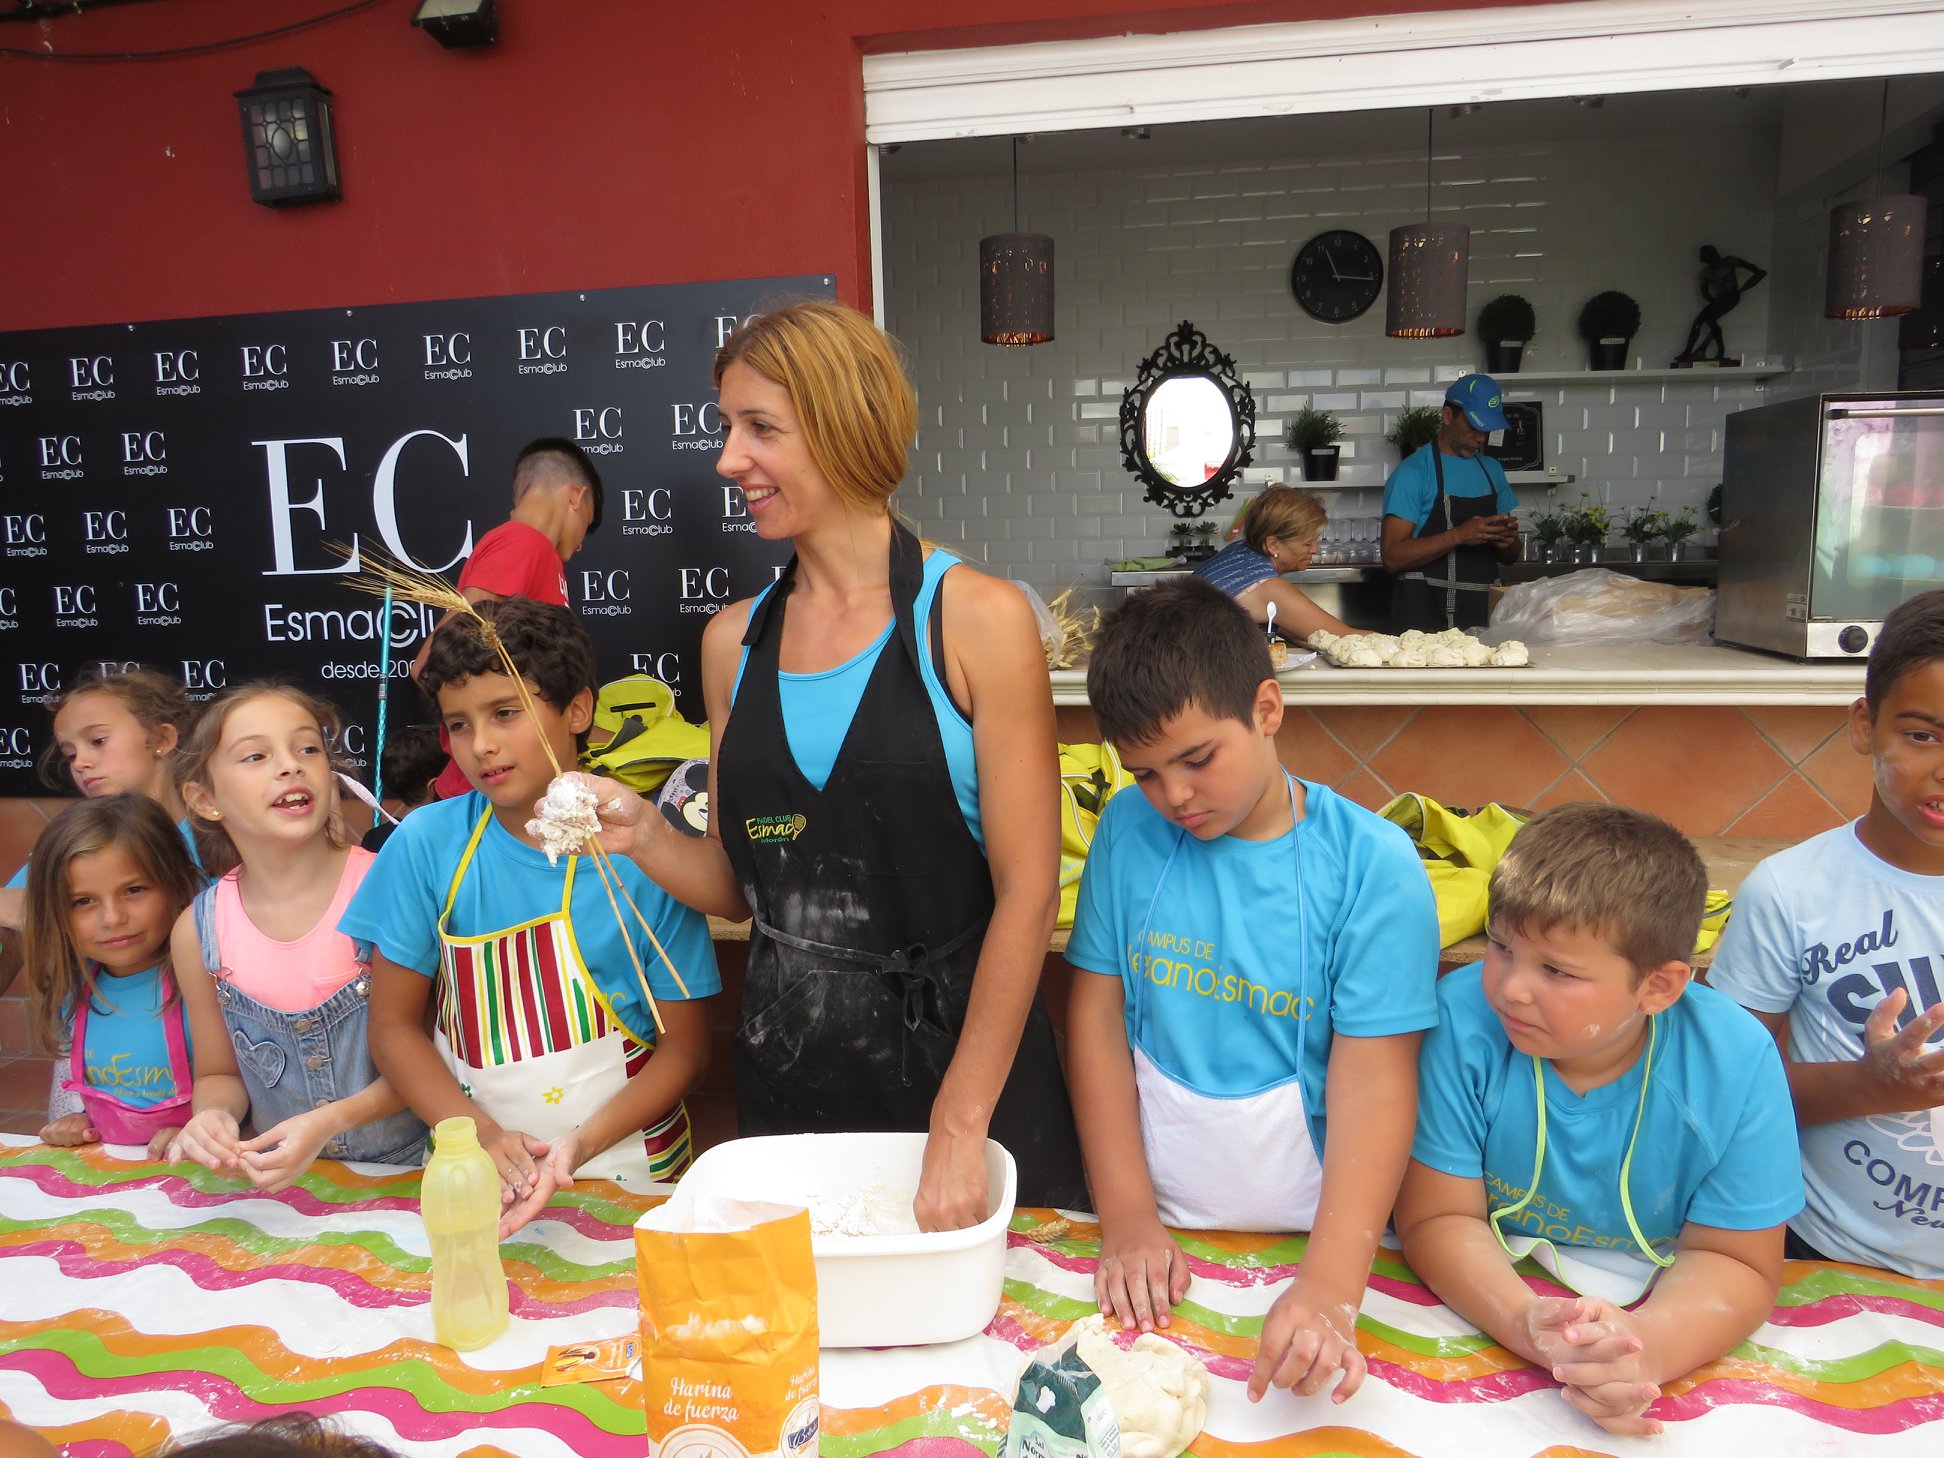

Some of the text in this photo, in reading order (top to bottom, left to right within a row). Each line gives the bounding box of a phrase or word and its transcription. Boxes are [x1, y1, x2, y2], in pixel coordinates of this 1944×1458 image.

[423, 333, 470, 365] EC
[517, 327, 566, 359] EC
[615, 321, 664, 353] EC
[155, 351, 199, 381] EC
[241, 345, 287, 376] EC
[331, 339, 377, 371] EC
[70, 356, 113, 387] EC
[0, 396, 32, 406] maClub
[573, 407, 622, 439] EC
[671, 403, 721, 435] EC
[40, 436, 81, 466] EC
[122, 431, 165, 461] EC
[581, 444, 623, 455] maClub
[251, 429, 474, 576] EC
[622, 489, 671, 520] EC
[721, 486, 747, 518] E
[4, 514, 45, 543] EC
[84, 511, 127, 540] EC
[167, 507, 211, 536] EC
[722, 522, 757, 534] EsmaC
[136, 583, 179, 611] EC
[581, 570, 629, 600] EC
[679, 568, 729, 598] EC
[0, 588, 16, 615] C
[54, 586, 96, 614] EC
[264, 600, 435, 649] EsmaCl
[19, 663, 60, 690] EC
[182, 660, 226, 688] EC
[321, 661, 380, 679] desde
[0, 759, 32, 768] maClub
[1194, 940, 1215, 960] DE
[1801, 909, 1898, 986] Real
[1546, 1202, 1571, 1222] DE
[670, 1377, 733, 1399] Harina
[663, 1399, 740, 1424] de fuerza
